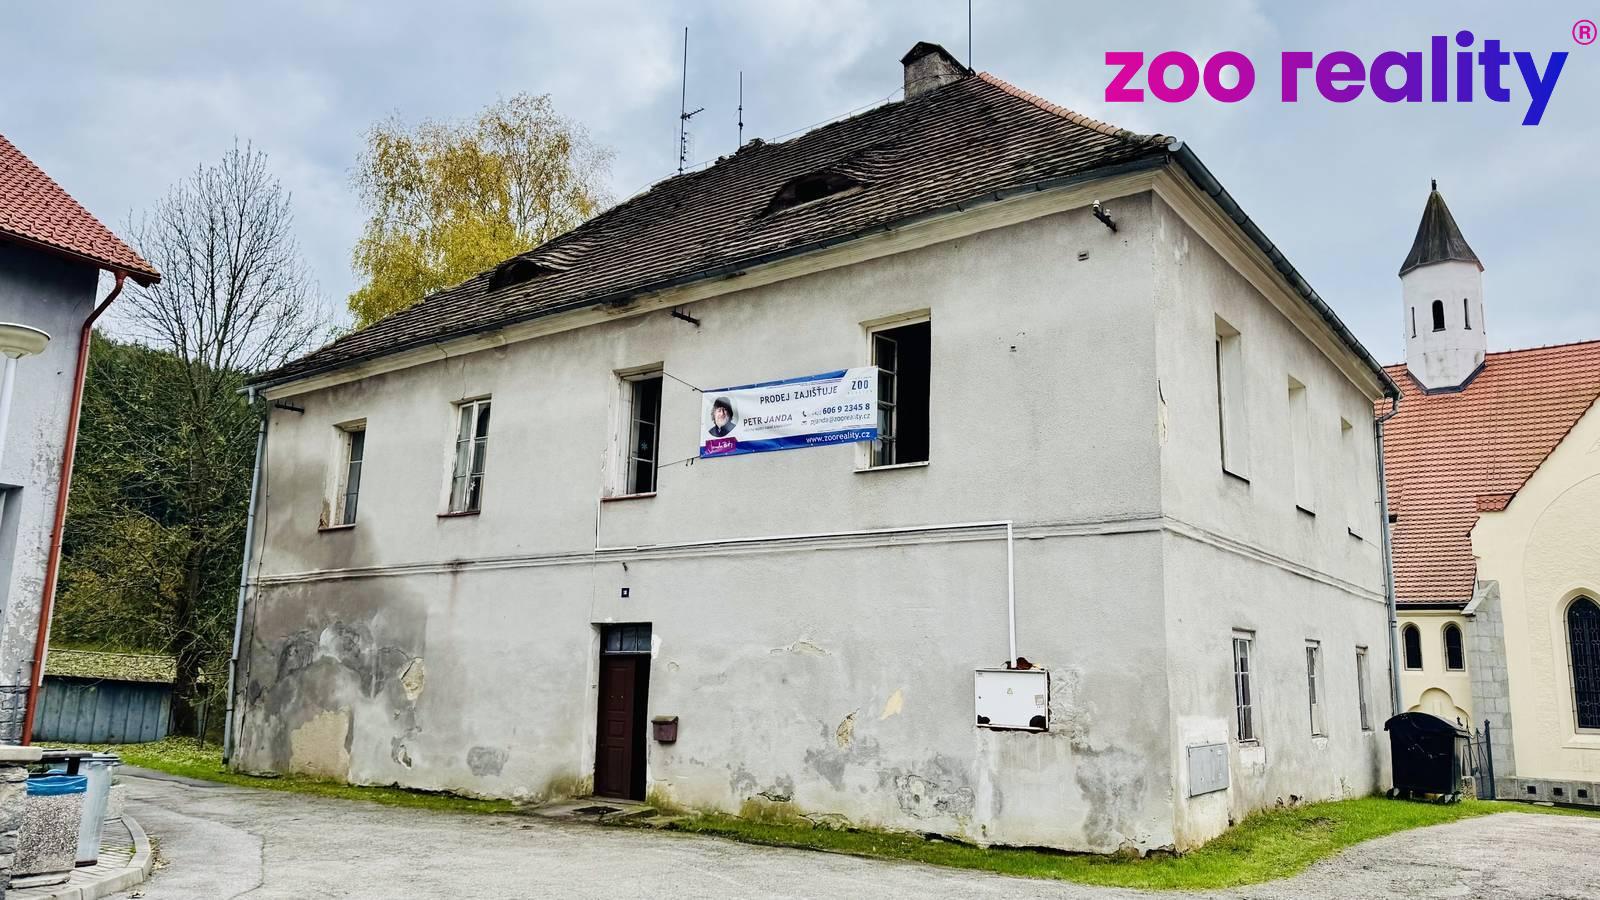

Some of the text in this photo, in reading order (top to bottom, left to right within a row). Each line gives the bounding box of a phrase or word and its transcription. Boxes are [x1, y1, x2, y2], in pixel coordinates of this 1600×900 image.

[851, 379, 869, 391] ZOO
[759, 393, 790, 405] PRODEJ
[794, 385, 839, 400] ZAJIŠŤUJE
[822, 405, 836, 415] 606
[837, 403, 843, 413] 9
[844, 401, 863, 412] 2345
[865, 400, 871, 411] 8
[743, 413, 793, 426] PETR JANDA
[805, 430, 871, 444] www.zooreality.cz
